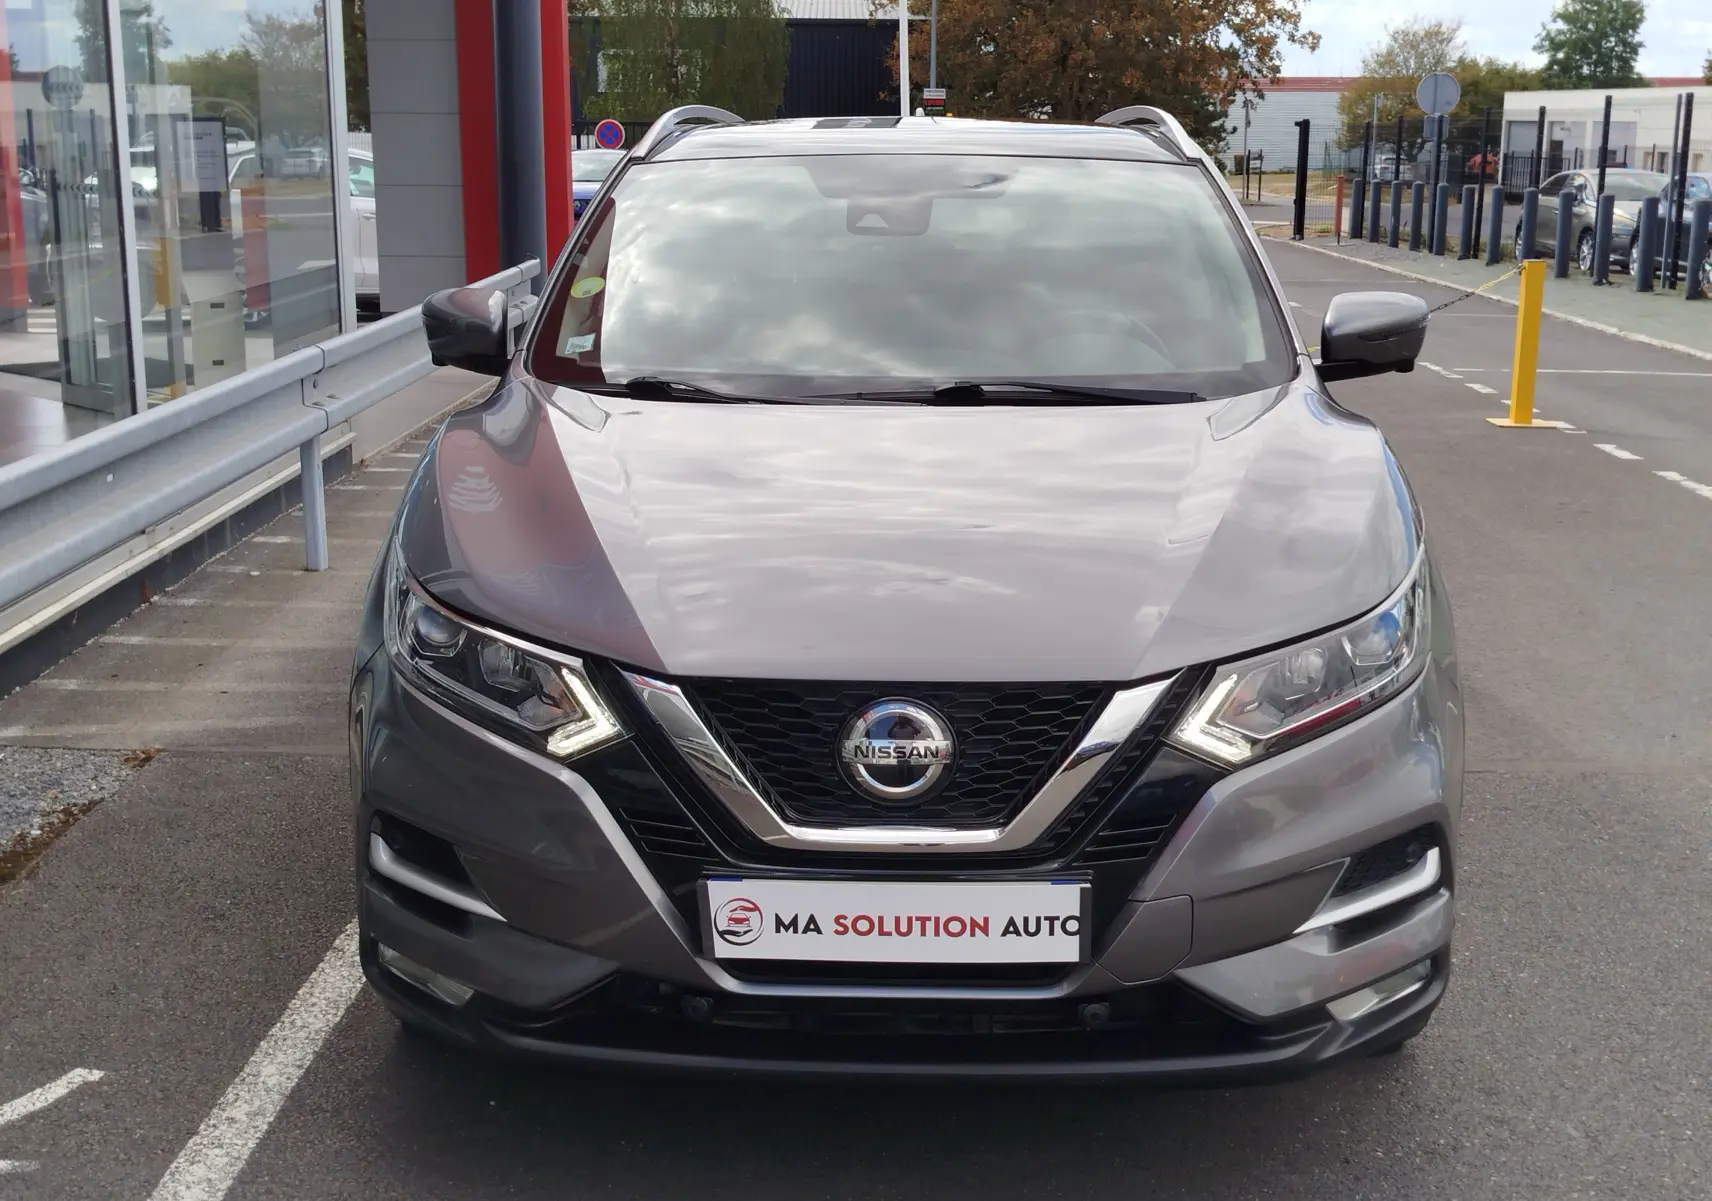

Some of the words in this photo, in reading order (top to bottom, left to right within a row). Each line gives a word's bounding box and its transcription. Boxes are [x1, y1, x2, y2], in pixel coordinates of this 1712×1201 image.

[854, 745, 939, 759] NISSAN
[774, 913, 823, 935] MA
[833, 914, 989, 938] SOLUTION
[1000, 915, 1080, 937] AUTO
